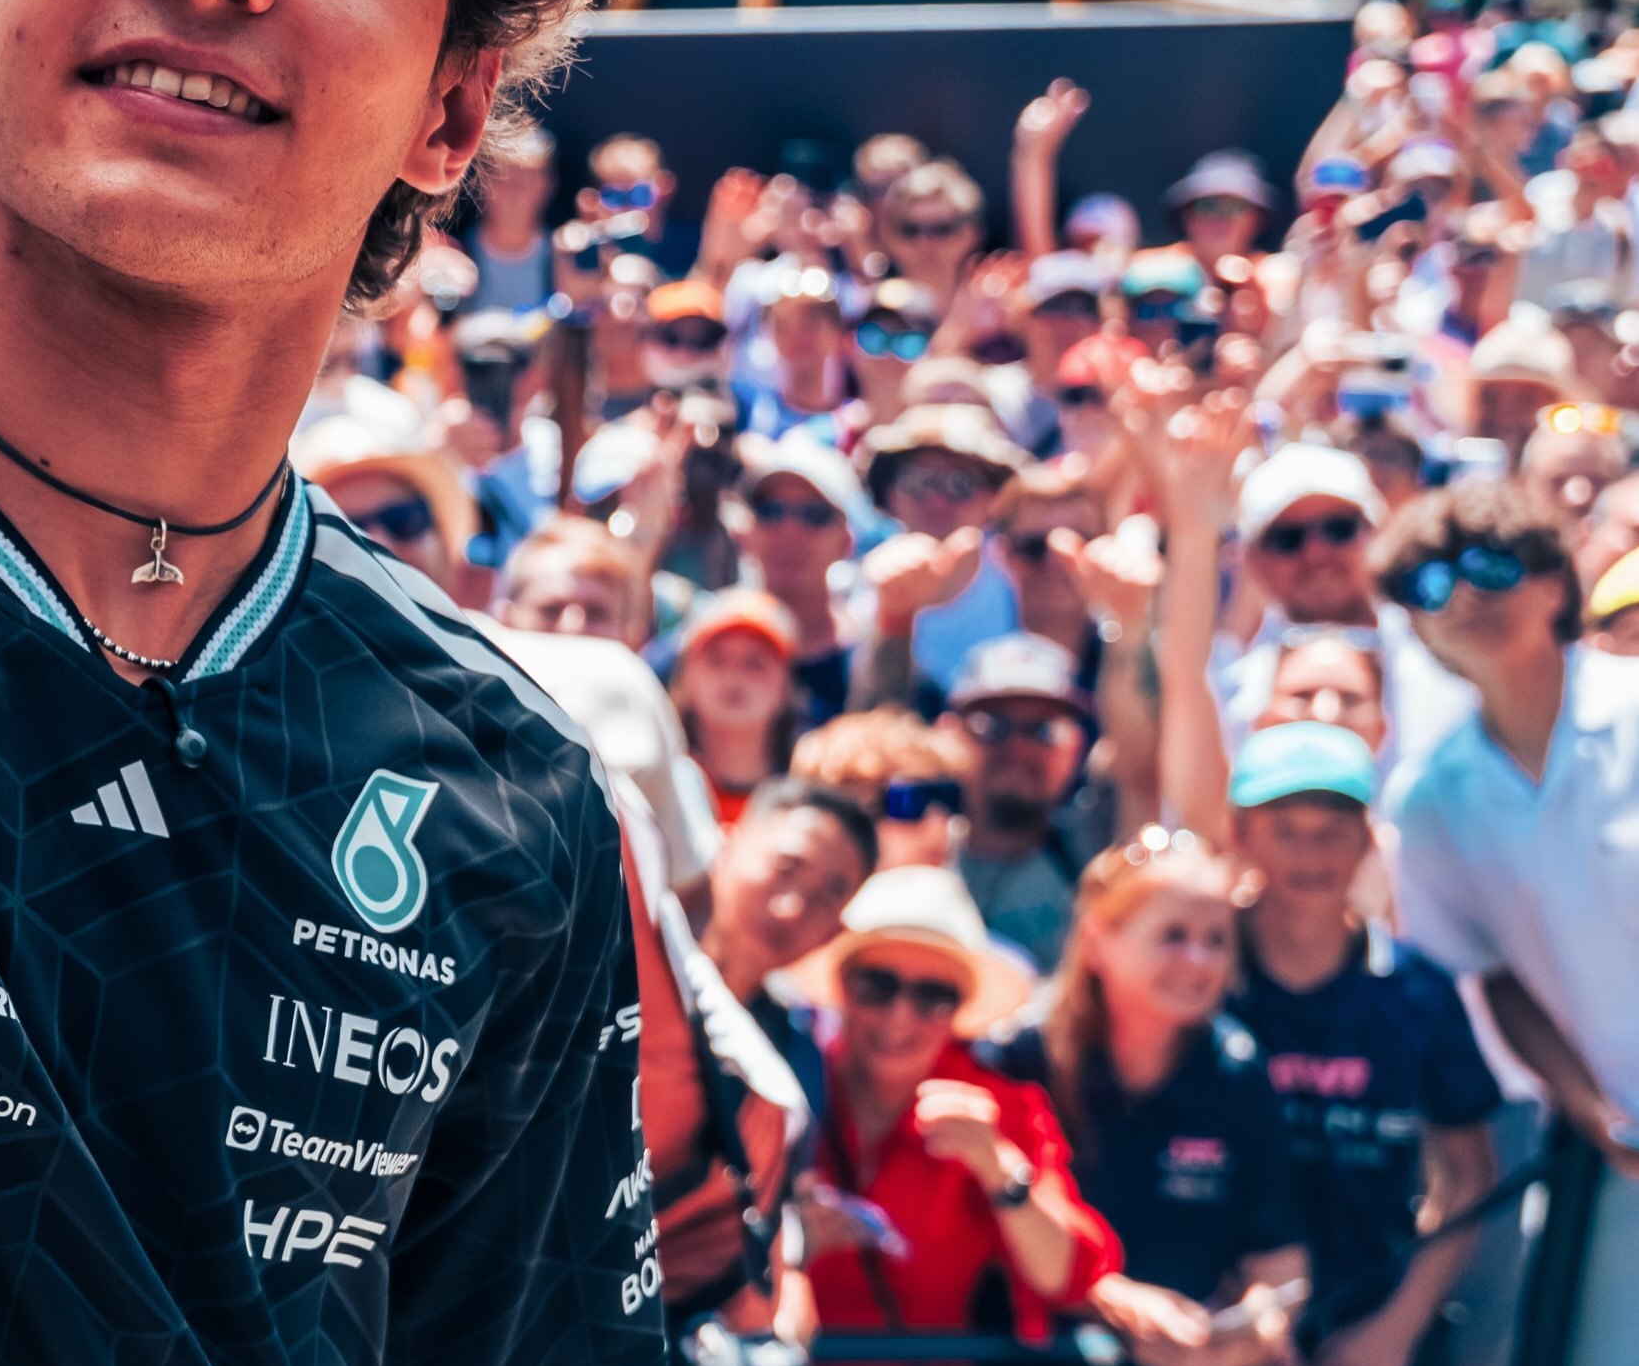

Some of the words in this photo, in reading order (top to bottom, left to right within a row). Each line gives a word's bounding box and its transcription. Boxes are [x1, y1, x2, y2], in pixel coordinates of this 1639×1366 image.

[292, 918, 457, 986] PETRONAS
[262, 993, 461, 1103] INEOS
[269, 1118, 419, 1177] TeamViewer
[243, 1199, 387, 1268] HPE
